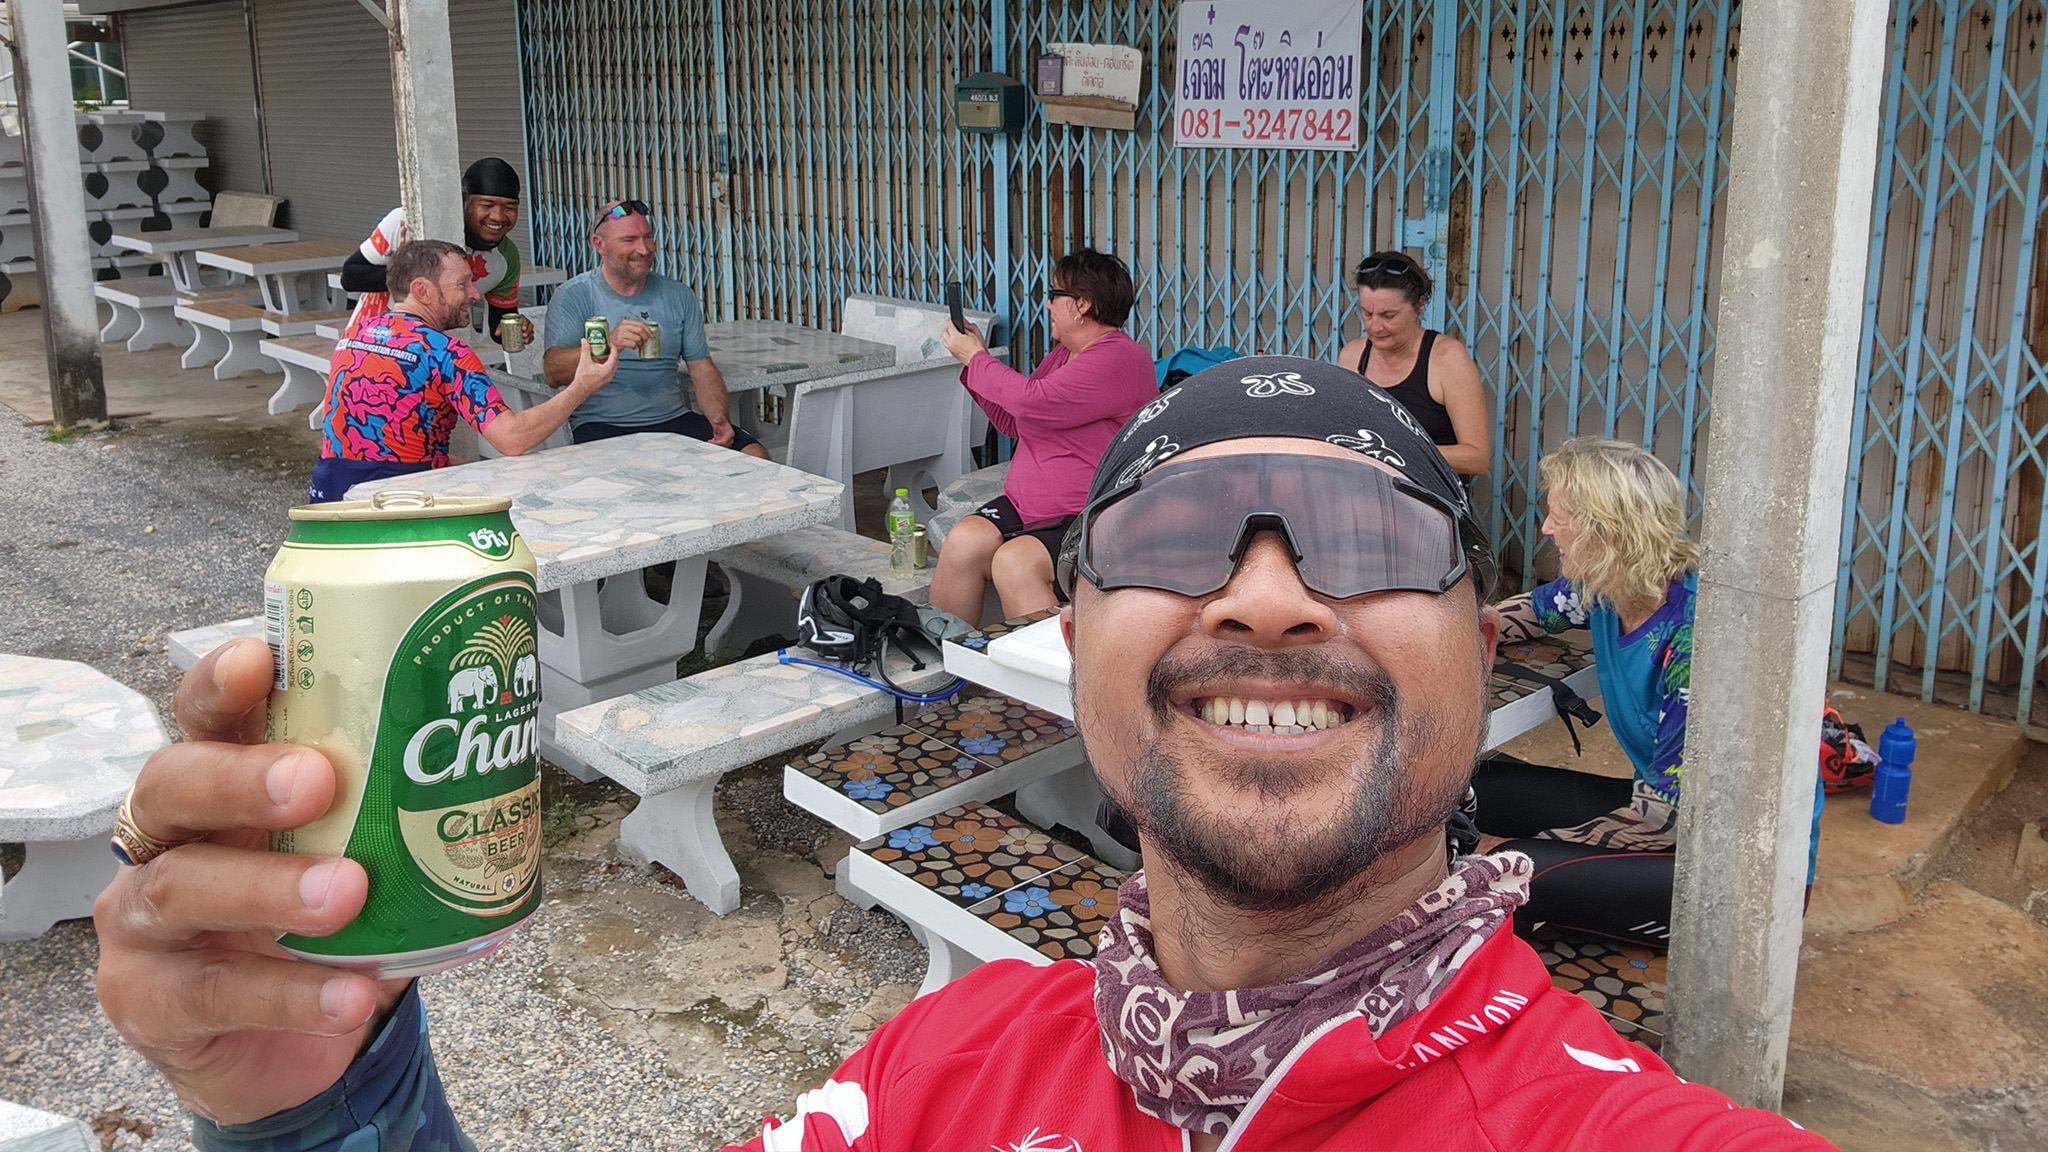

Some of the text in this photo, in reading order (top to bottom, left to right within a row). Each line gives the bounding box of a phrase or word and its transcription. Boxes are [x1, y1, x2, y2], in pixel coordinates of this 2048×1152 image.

[1234, 24, 1354, 101] โต๊ะหินอ่อน
[1180, 107, 1353, 142] 081-3247842
[390, 348, 418, 363] STARTER
[467, 527, 509, 550] ช้าง
[413, 602, 485, 665] PRODUCT
[494, 594, 511, 605] OF
[495, 704, 531, 722] LAGER
[403, 715, 540, 785] Chan
[488, 831, 525, 857] BEER
[453, 875, 491, 891] NATURAL
[1396, 989, 1529, 1071] ANYON
